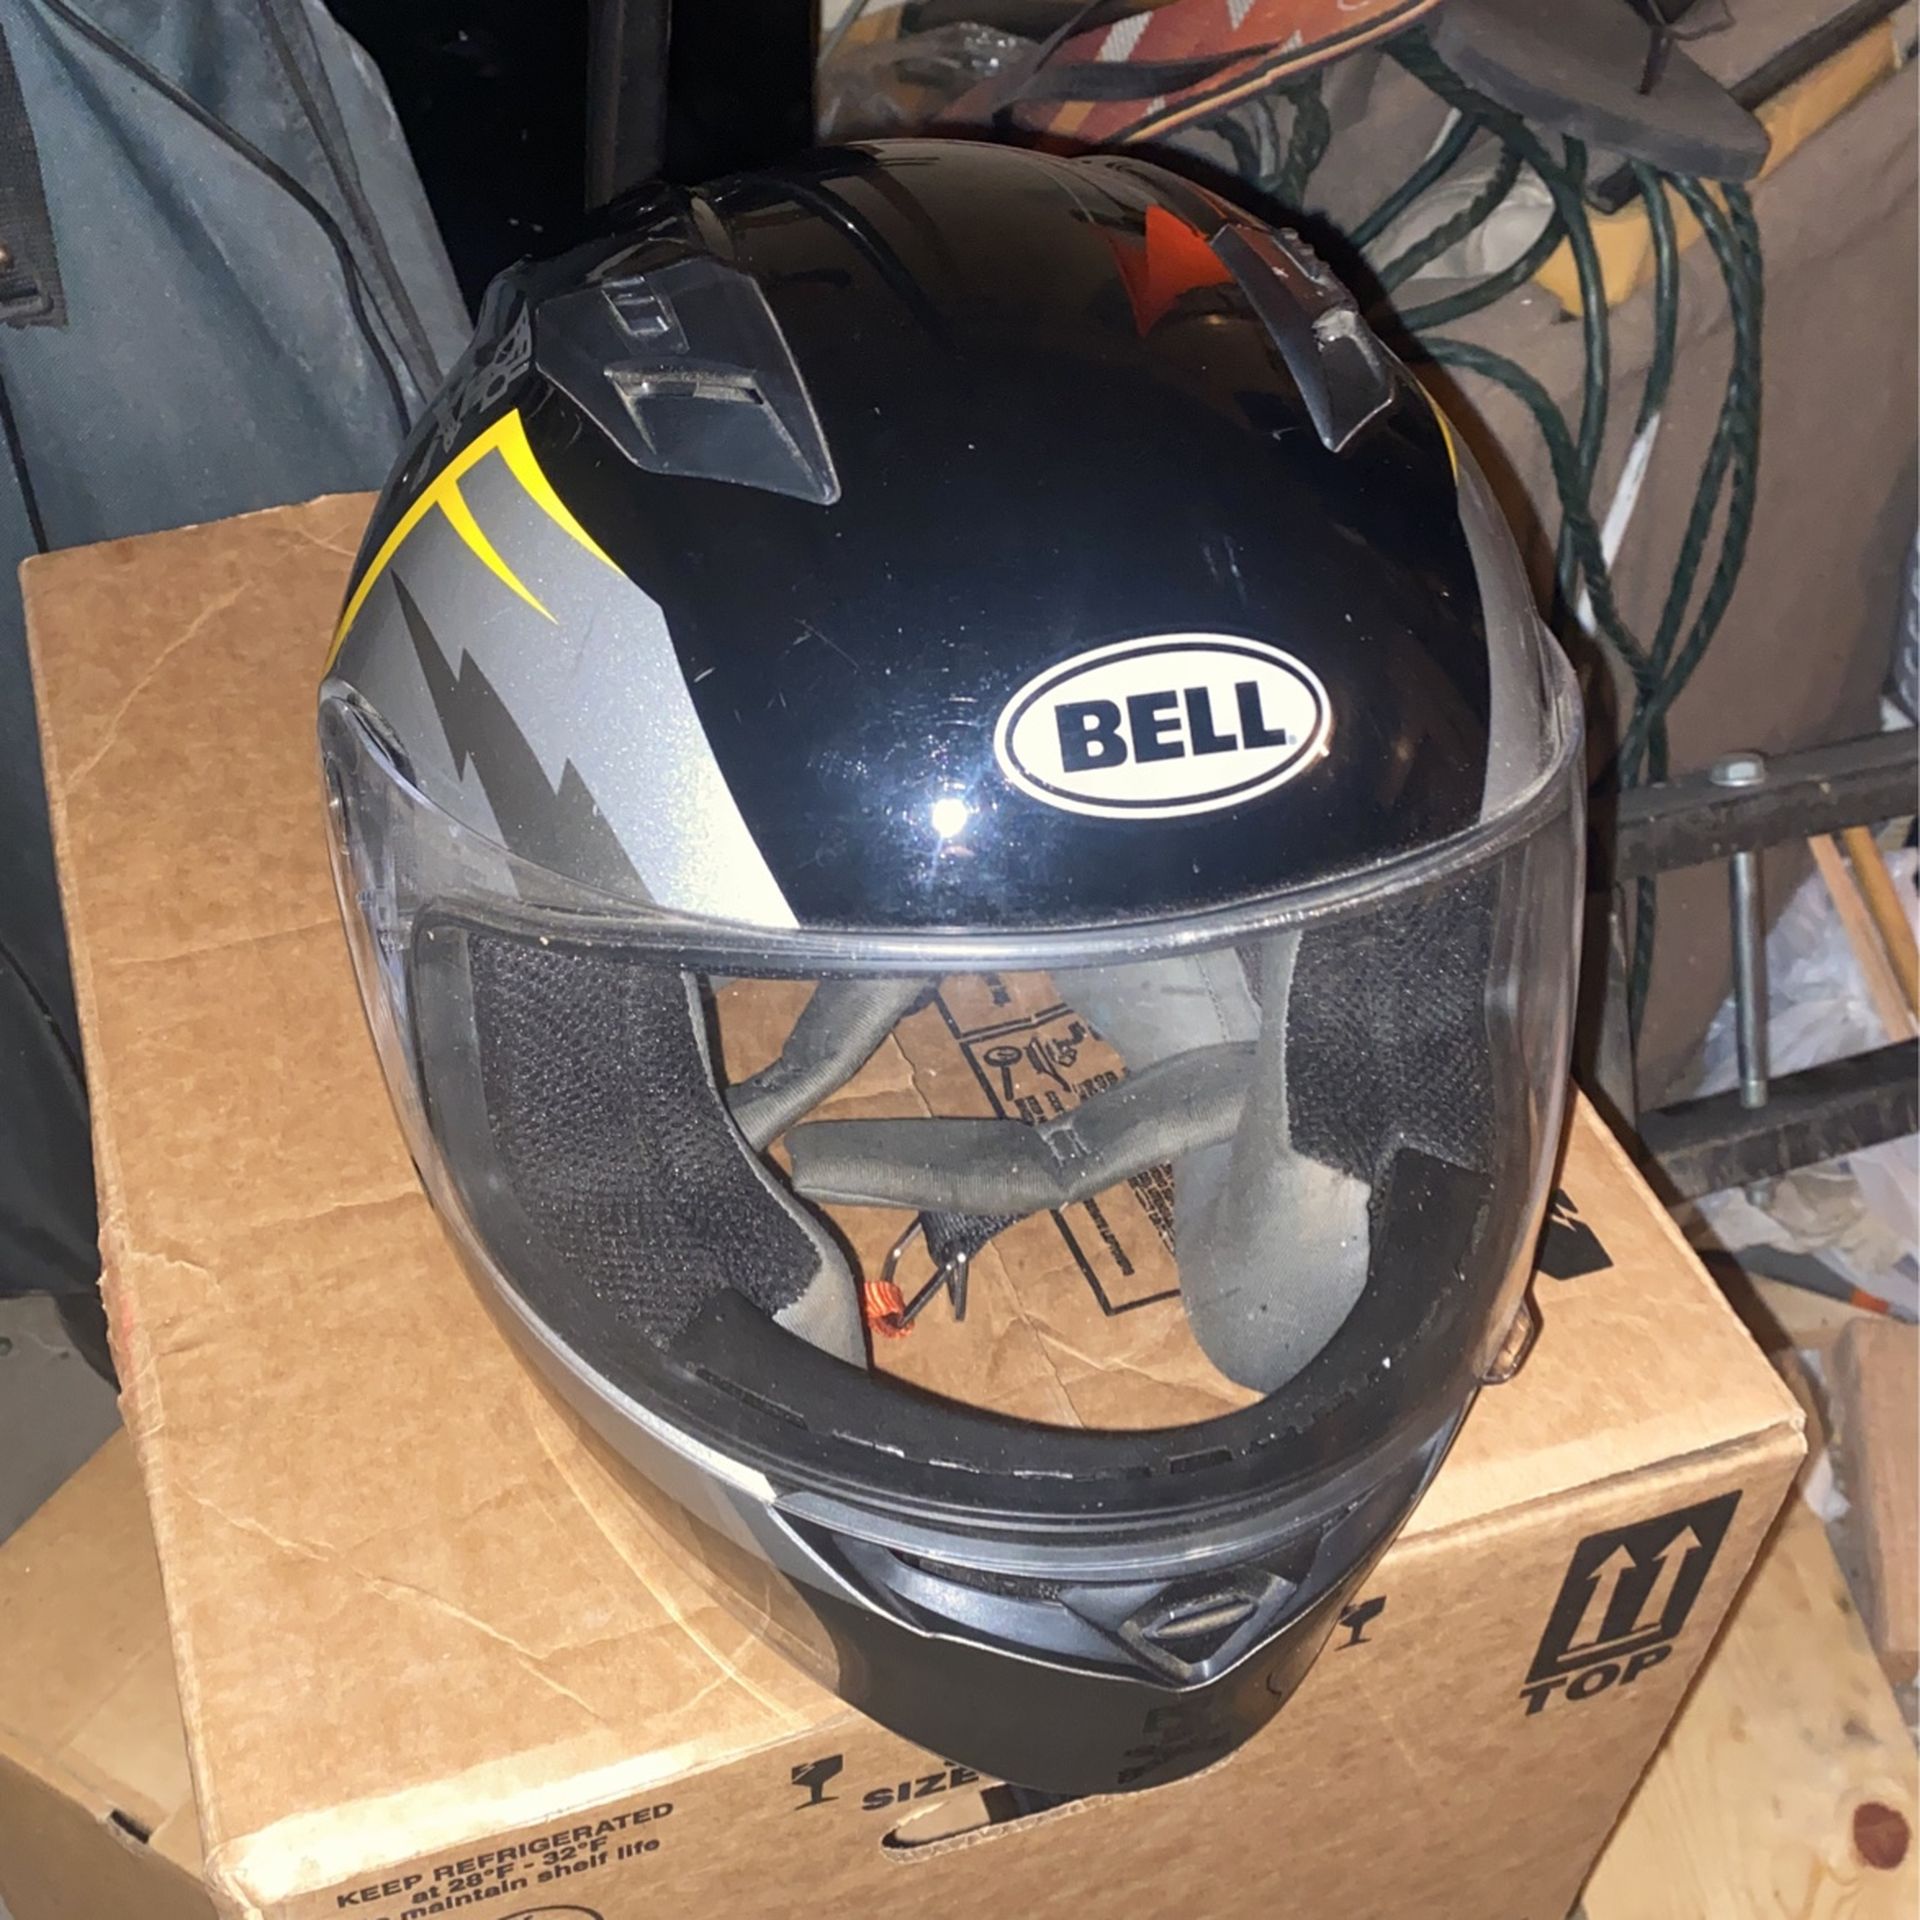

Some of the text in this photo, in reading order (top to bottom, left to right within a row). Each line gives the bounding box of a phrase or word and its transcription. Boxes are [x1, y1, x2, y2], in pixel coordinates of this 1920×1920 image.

[1053, 680, 1287, 773] BELL
[1519, 1645, 1672, 1716] TOP
[336, 1802, 674, 1908] KEEP REFRIGERATED
[400, 1839, 660, 1920] maintain shelf life
[411, 1886, 441, 1904] at
[447, 1862, 515, 1894] 28°F
[542, 1836, 608, 1866] 32°F
